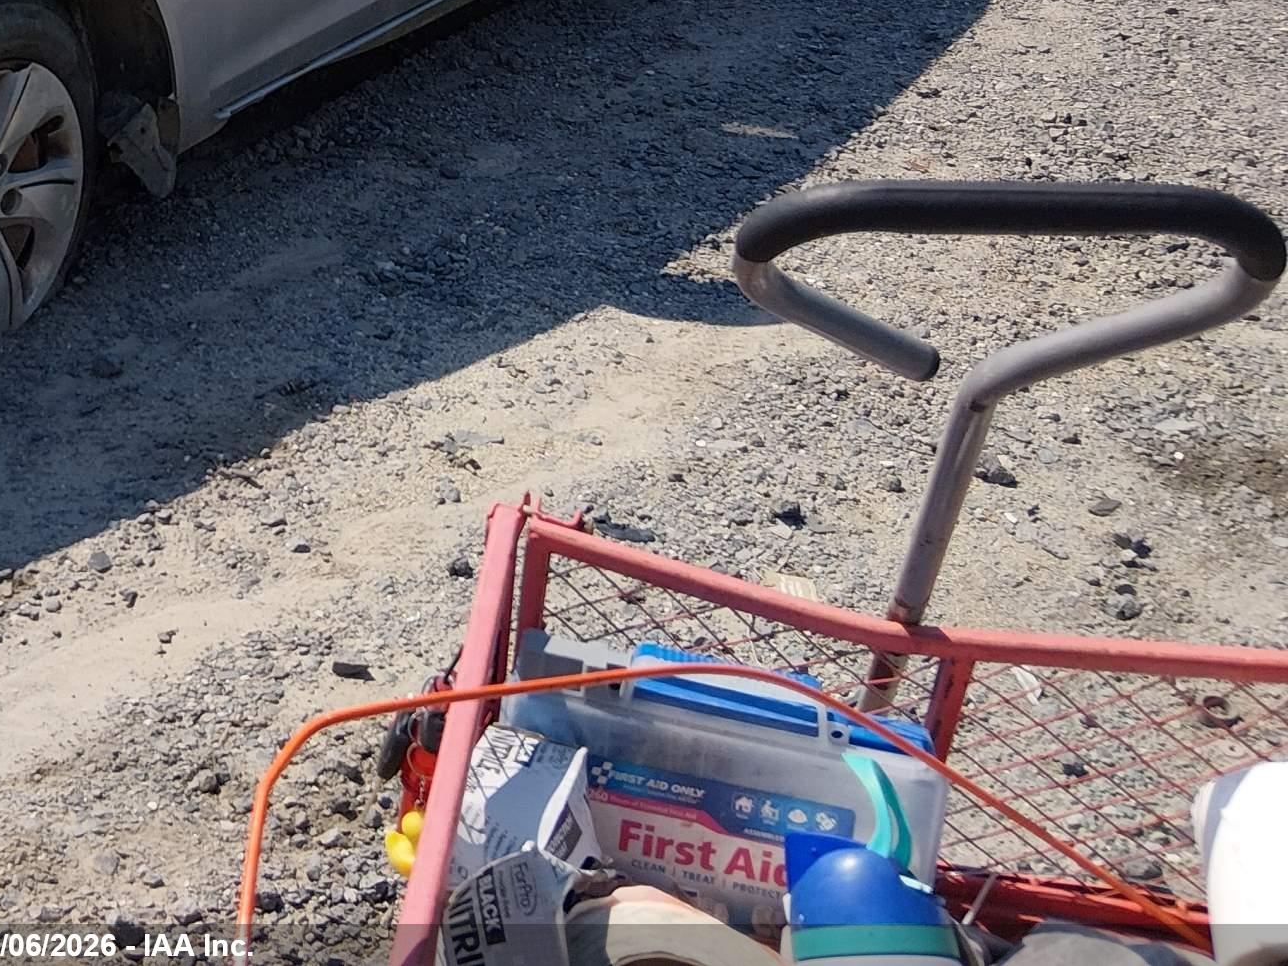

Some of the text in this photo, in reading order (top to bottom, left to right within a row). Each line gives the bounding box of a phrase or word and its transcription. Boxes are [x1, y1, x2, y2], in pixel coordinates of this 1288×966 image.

[608, 769, 645, 785] FIRST
[647, 779, 669, 791] AID
[671, 784, 704, 798] ONLY
[618, 819, 717, 871] First
[478, 874, 503, 933] BLACK
[631, 859, 781, 900] CLEAN TREAT PROTECT
[449, 886, 485, 966] NITRI
